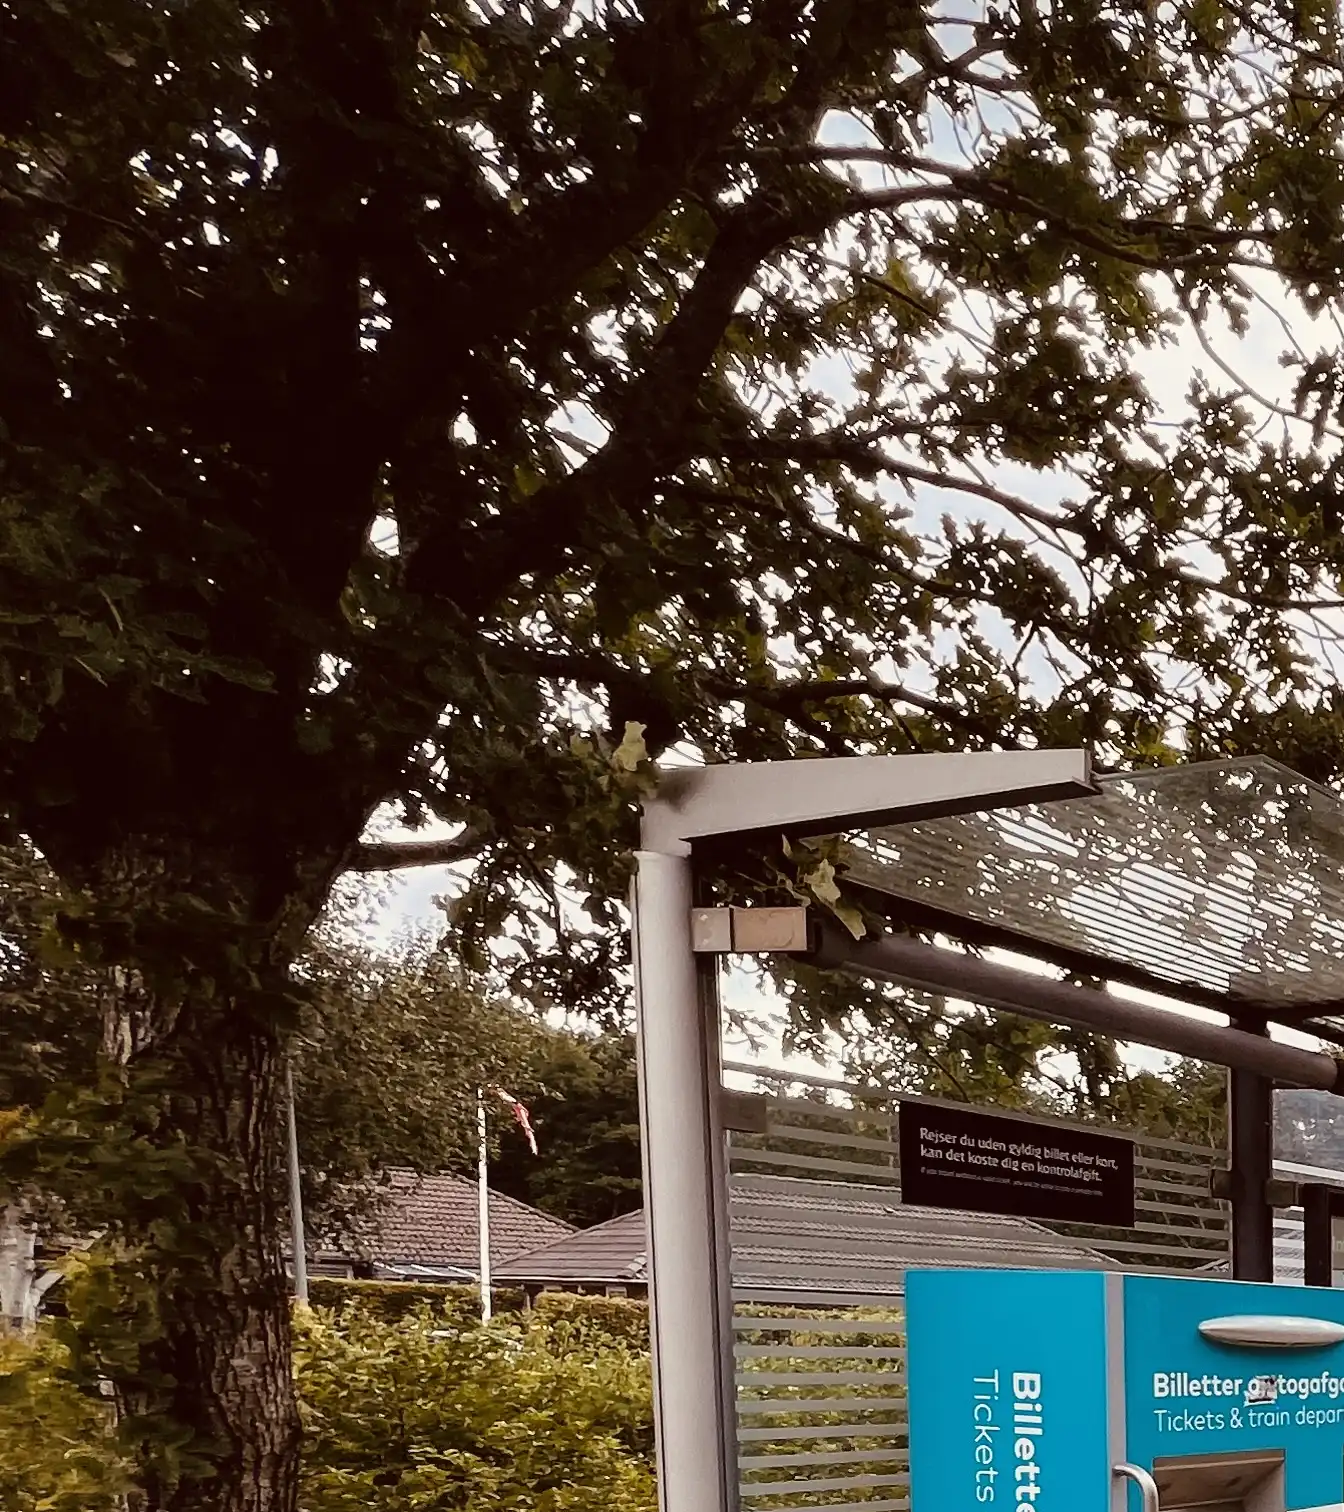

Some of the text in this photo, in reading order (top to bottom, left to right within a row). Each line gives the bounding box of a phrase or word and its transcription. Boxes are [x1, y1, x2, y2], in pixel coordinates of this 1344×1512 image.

[920, 1127, 957, 1144] Rejser
[960, 1134, 975, 1147] du
[978, 1136, 1006, 1151] uden
[1008, 1142, 1041, 1159] gyldig
[1044, 1146, 1069, 1162] billet
[1072, 1152, 1094, 1164] eller
[920, 1143, 943, 1158] kan
[946, 1149, 965, 1162] det
[968, 1151, 998, 1167] koste
[1001, 1158, 1019, 1171] dig
[1021, 1162, 1035, 1172] en
[1153, 1372, 1243, 1397] Billetter
[1153, 1408, 1225, 1432] Tickets
[1230, 1407, 1244, 1428] &
[1248, 1406, 1290, 1427] train
[973, 1369, 1000, 1502] Tickets
